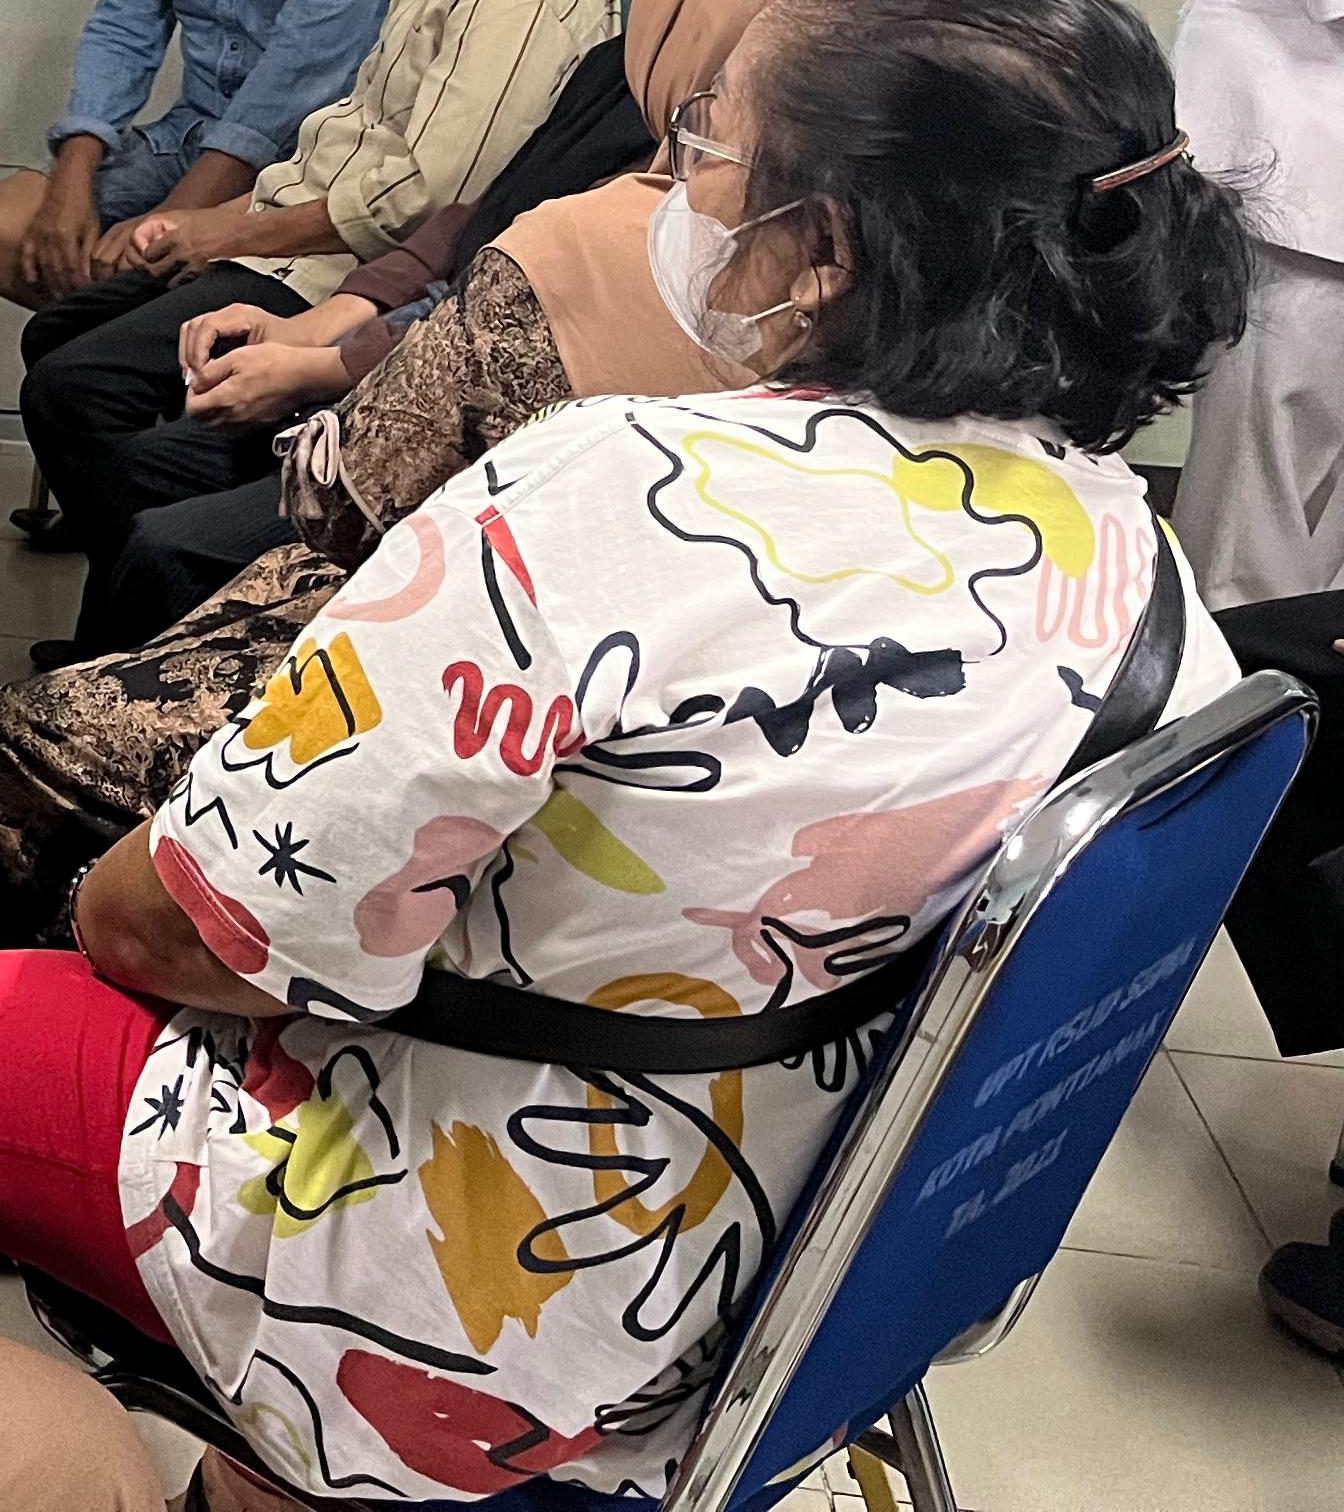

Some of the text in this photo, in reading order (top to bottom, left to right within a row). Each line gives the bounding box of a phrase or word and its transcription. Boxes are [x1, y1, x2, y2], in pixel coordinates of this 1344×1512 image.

[914, 1008, 1165, 1208] KOTA PONTIANAK
[973, 1039, 1044, 1109] UPT
[1036, 986, 1126, 1068] RSUD
